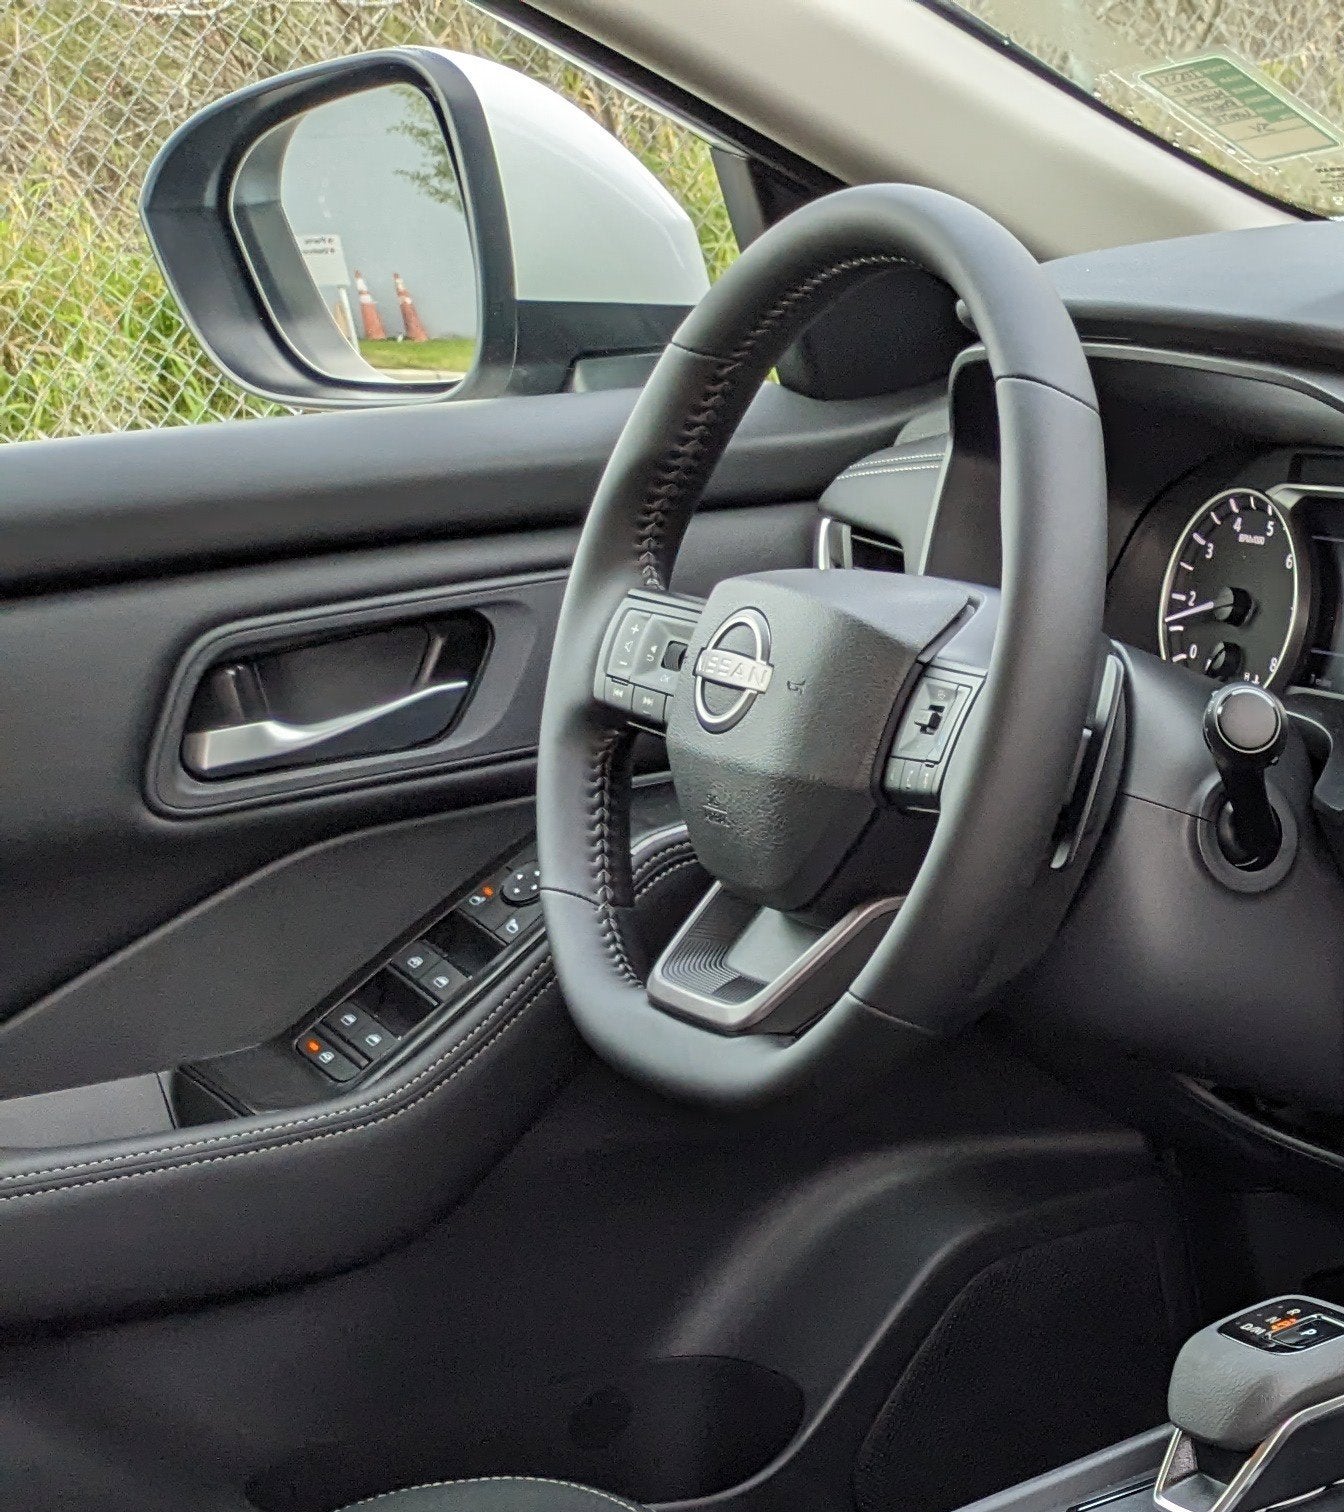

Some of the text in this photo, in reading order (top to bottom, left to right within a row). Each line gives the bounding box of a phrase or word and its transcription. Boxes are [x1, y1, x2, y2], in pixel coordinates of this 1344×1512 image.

[1233, 517, 1241, 532] 4
[1266, 521, 1274, 537] 5
[1205, 543, 1214, 559] 3
[1285, 554, 1293, 569] 6
[1188, 591, 1196, 606] 2
[1189, 644, 1197, 658] 0
[1270, 657, 1278, 672] 8
